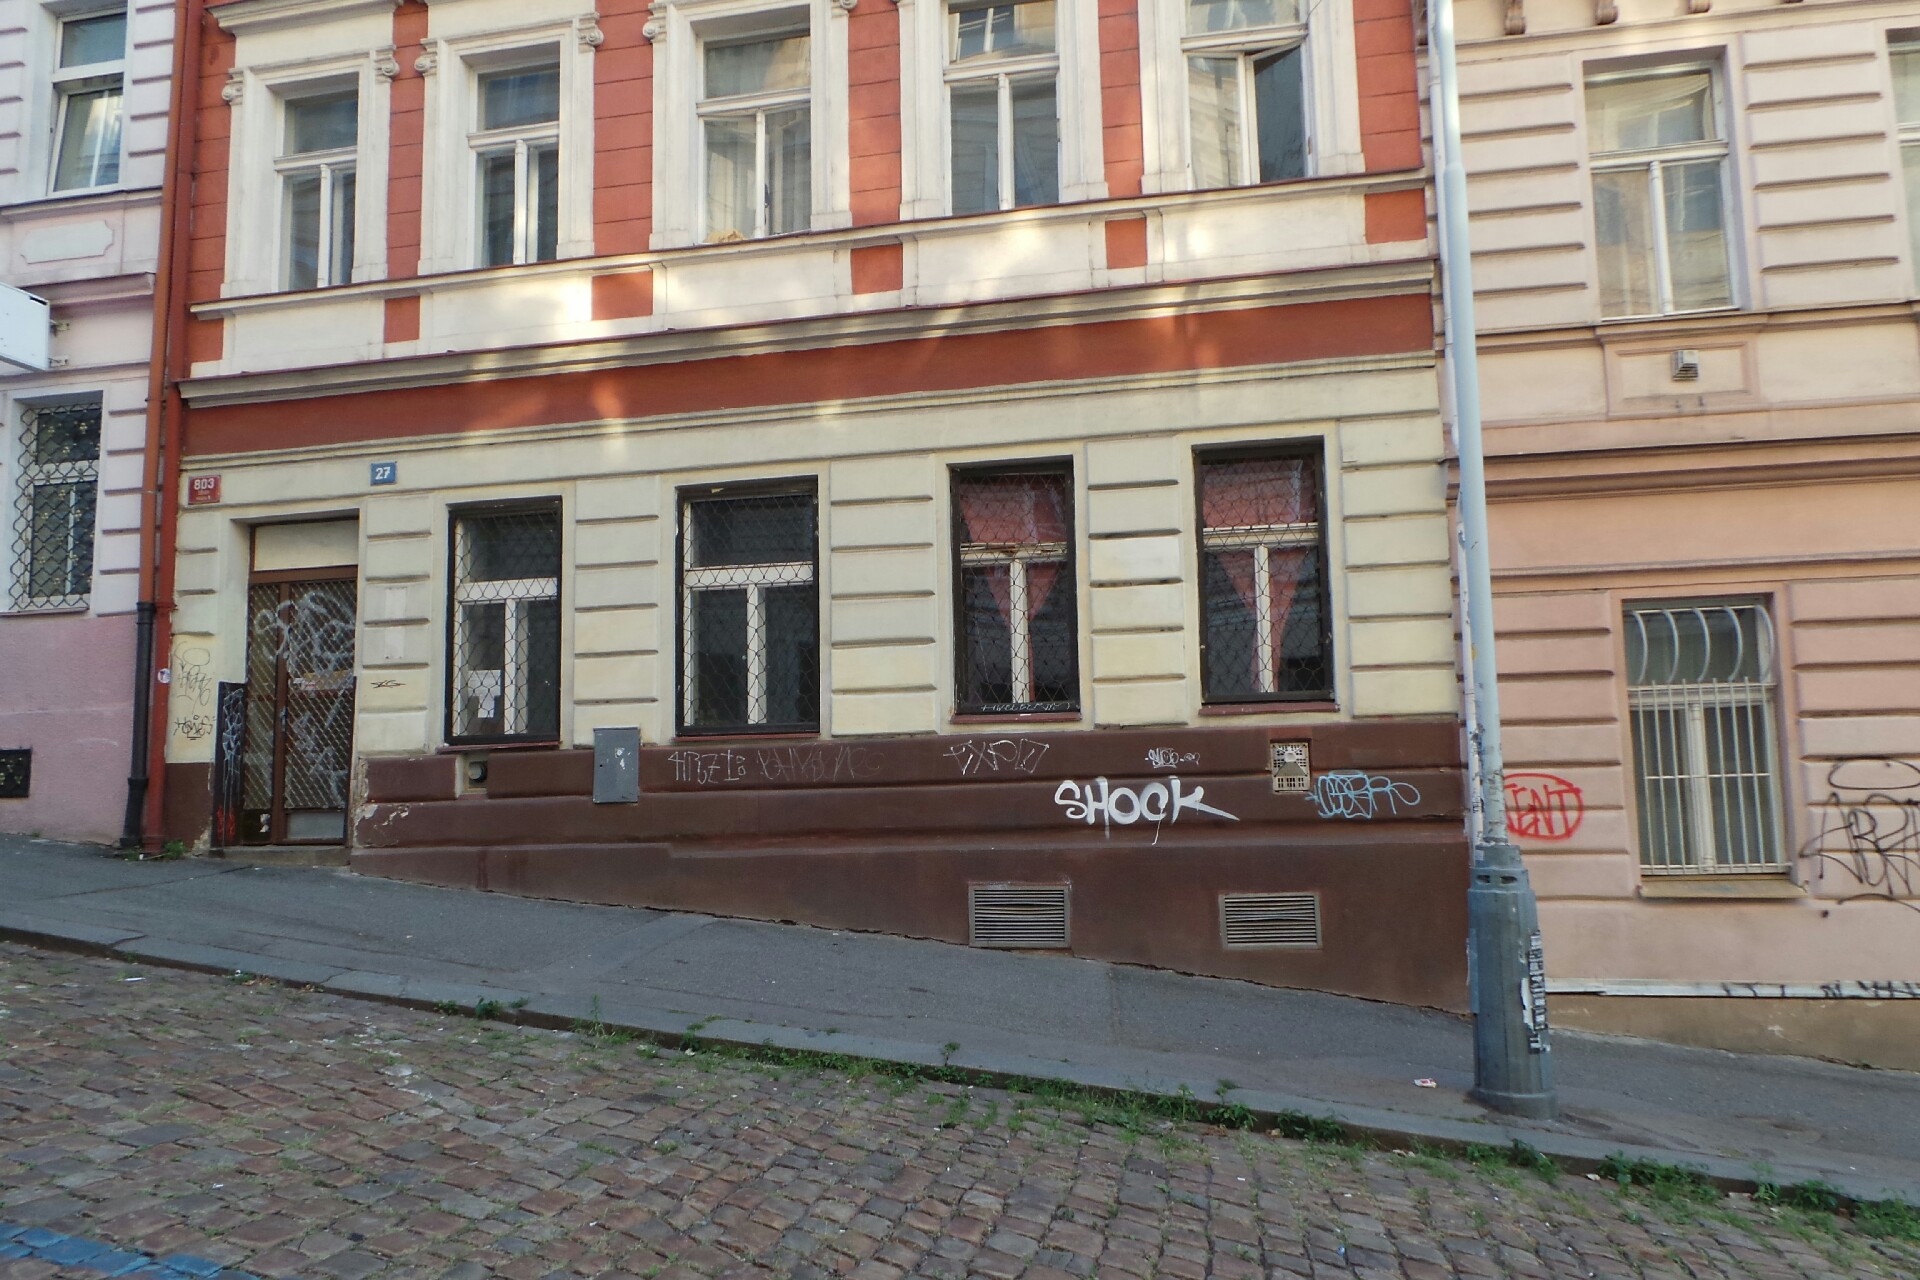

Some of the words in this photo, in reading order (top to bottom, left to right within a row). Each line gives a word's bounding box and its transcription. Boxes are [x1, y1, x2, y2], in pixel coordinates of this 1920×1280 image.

[375, 466, 391, 480] 27
[193, 478, 215, 490] 803
[1055, 775, 1241, 826] SHOCK
